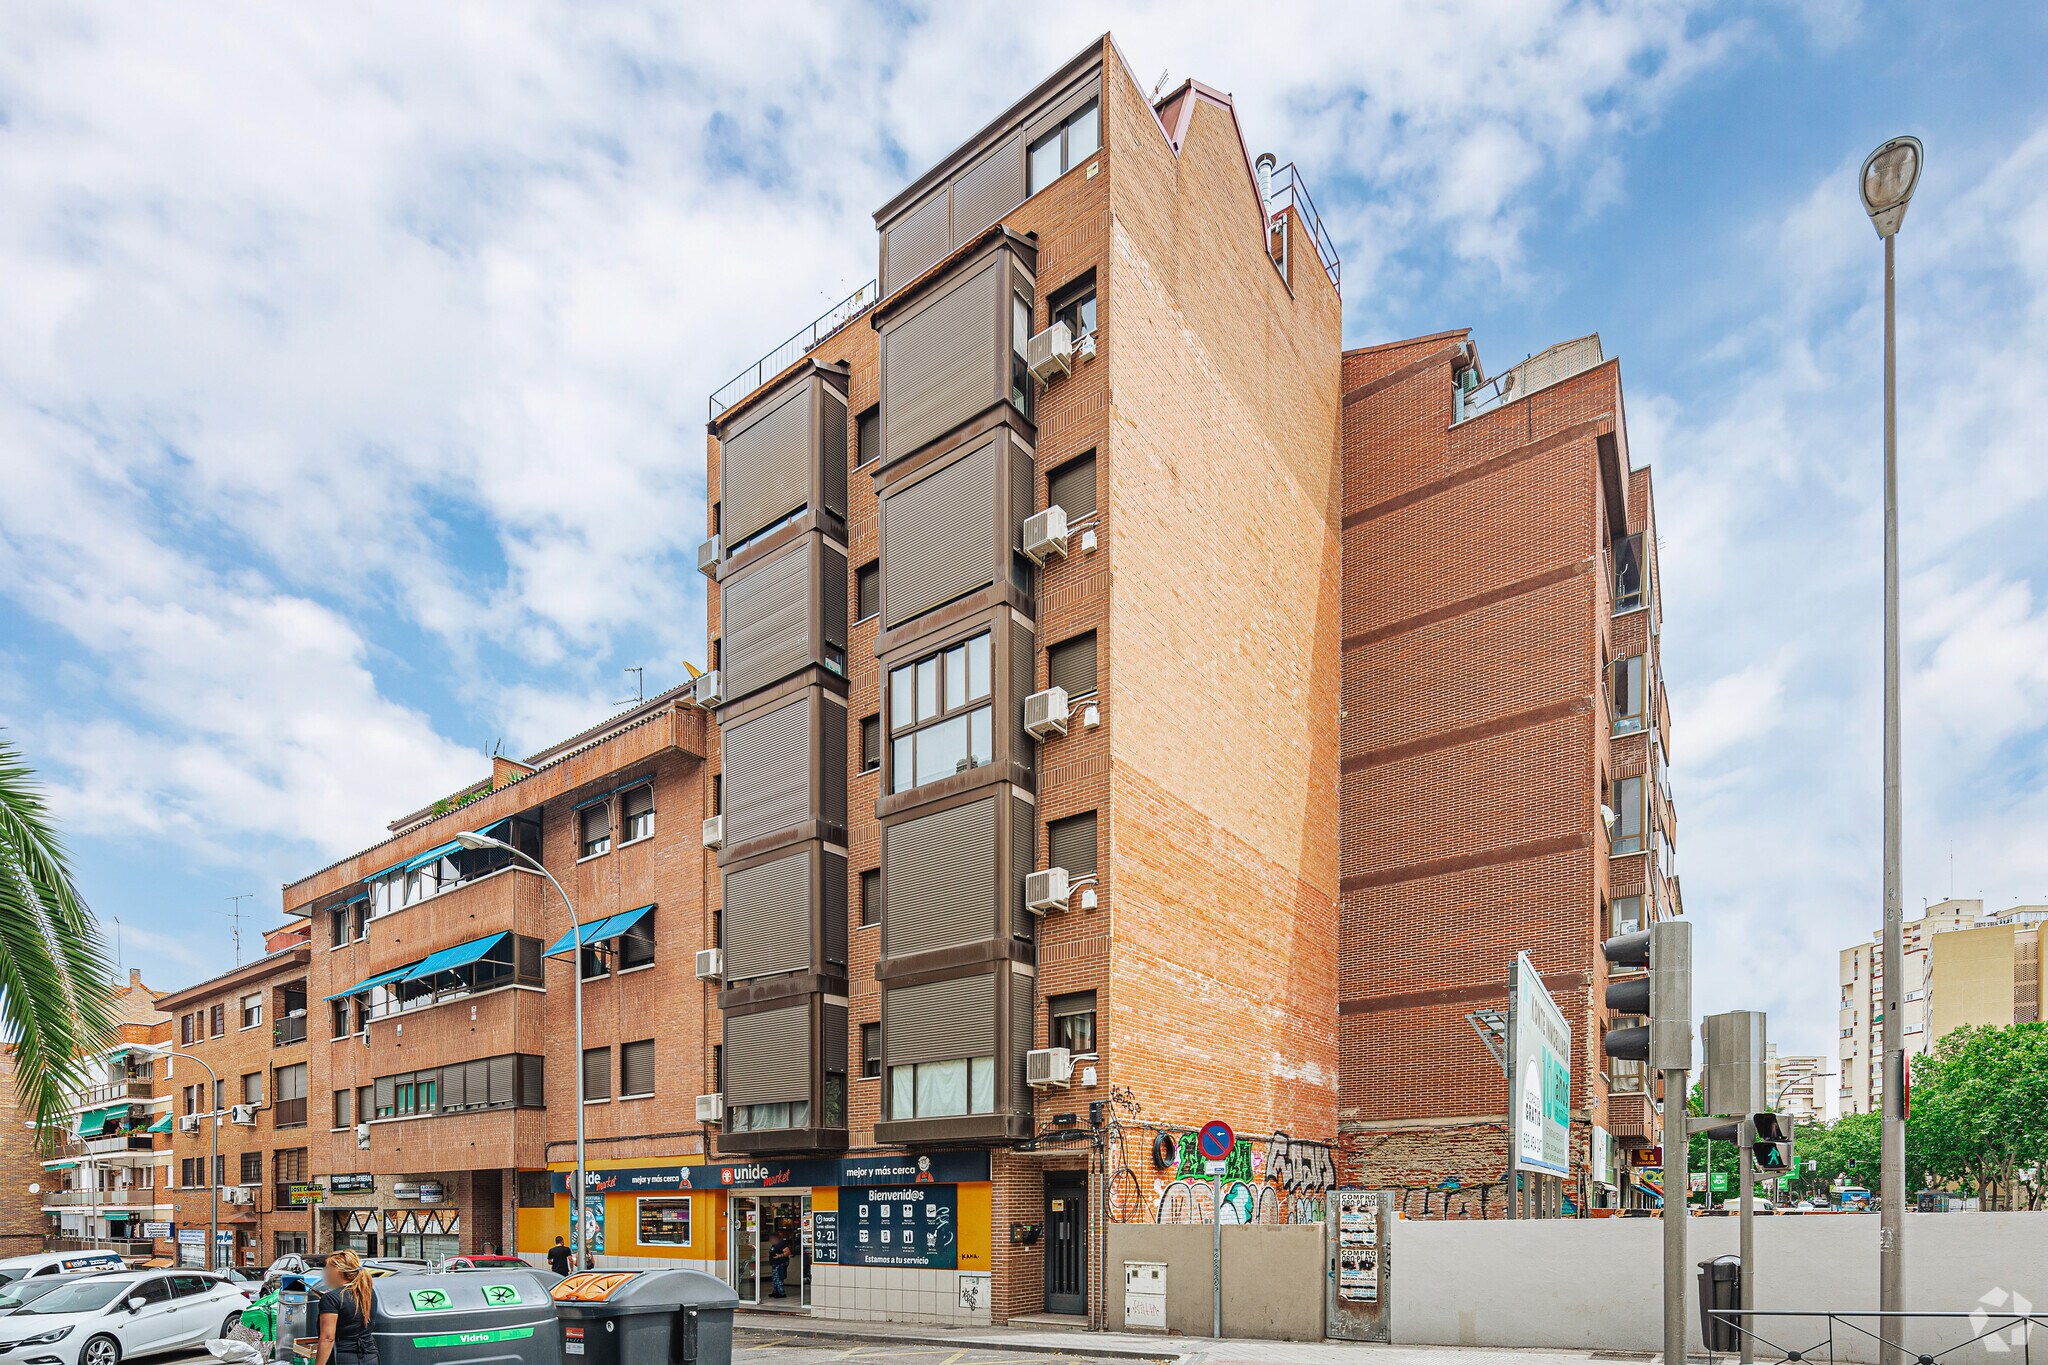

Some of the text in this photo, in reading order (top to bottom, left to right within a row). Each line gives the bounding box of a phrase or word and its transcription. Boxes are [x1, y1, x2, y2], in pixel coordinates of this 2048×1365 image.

[734, 1164, 791, 1187] unide market
[846, 1165, 916, 1178] mejor y más cerca
[585, 1171, 617, 1191] ide market
[632, 1175, 647, 1185] mejor
[647, 1175, 652, 1184] y
[652, 1174, 663, 1182] más
[868, 1188, 925, 1202] Bienvenid@s
[816, 1230, 822, 1241] 9
[826, 1230, 835, 1241] 21
[815, 1249, 823, 1259] 10
[828, 1249, 837, 1259] 15
[864, 1255, 890, 1263] Estamos
[895, 1256, 903, 1264] tu
[903, 1256, 929, 1265] servicio
[460, 1334, 490, 1343] Vidrio
